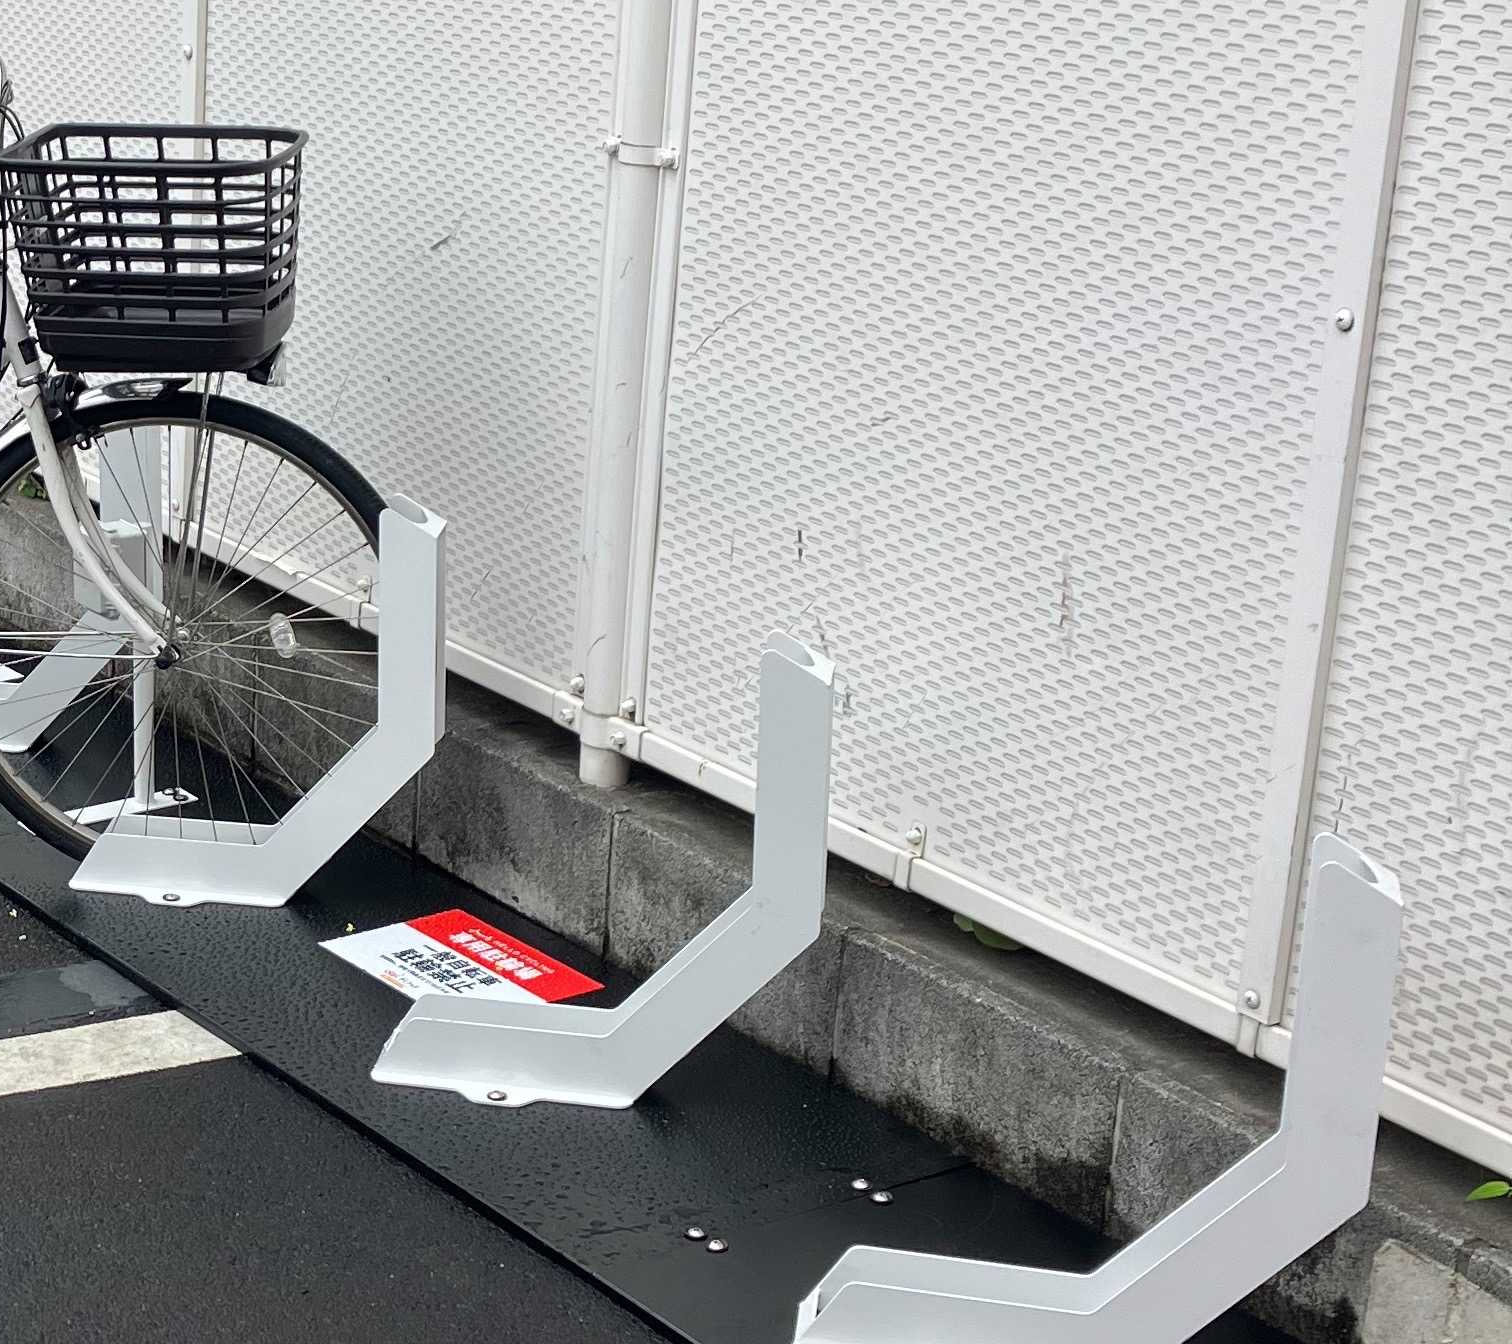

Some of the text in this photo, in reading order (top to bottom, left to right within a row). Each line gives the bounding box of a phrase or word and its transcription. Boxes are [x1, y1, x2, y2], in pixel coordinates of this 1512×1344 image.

[392, 948, 476, 994] 駐輪禁止
[423, 944, 502, 986] 一般自転車
